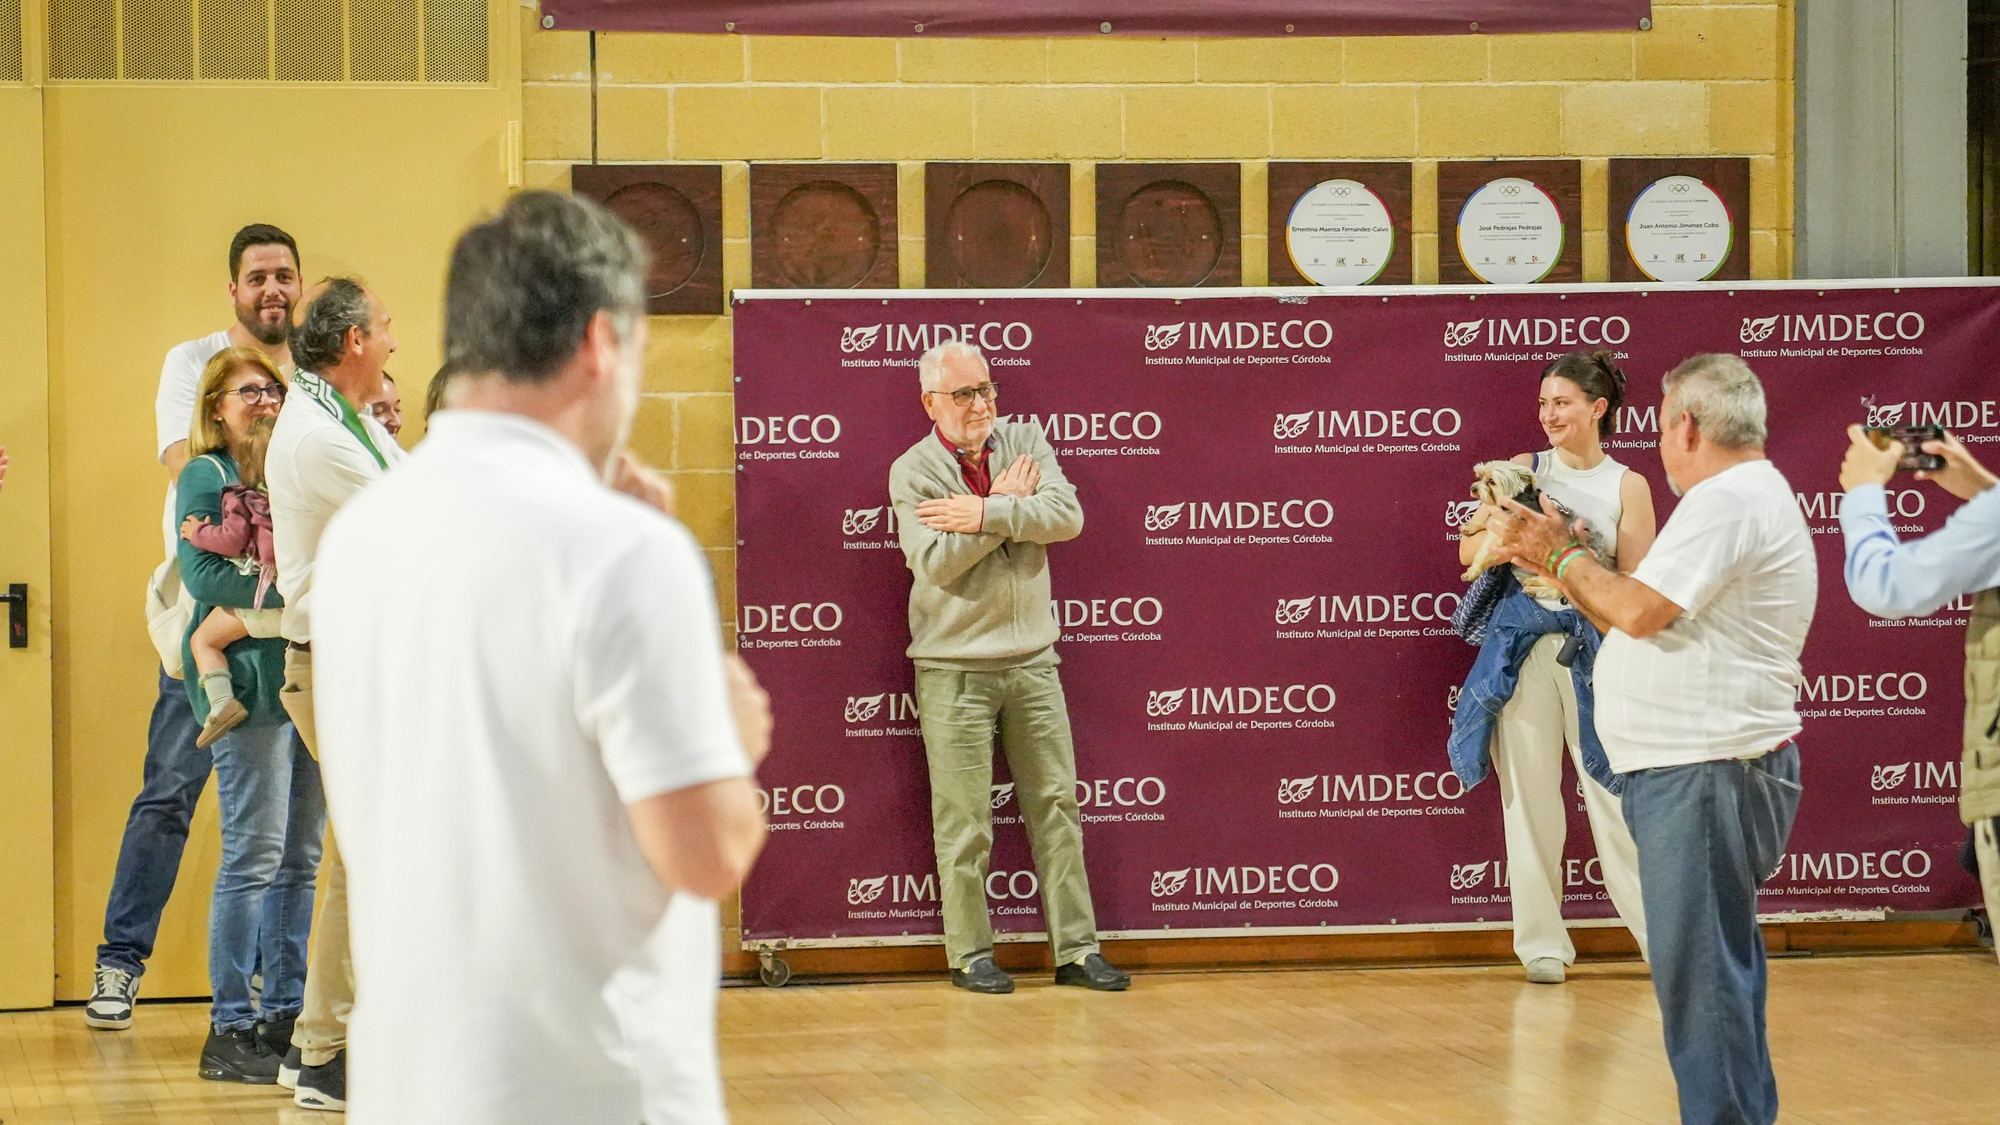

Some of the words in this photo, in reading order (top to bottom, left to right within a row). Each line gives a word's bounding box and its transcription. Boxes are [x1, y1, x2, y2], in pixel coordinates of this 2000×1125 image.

[1488, 316, 1630, 346] IMDECO
[1783, 312, 1925, 342] IMDECO
[886, 322, 1032, 351] IMDECO
[1189, 320, 1333, 349] IMDECO
[1445, 353, 1482, 362] Instituto
[1484, 352, 1529, 363] Municipal
[1531, 352, 1543, 361] de
[1741, 349, 1778, 358] Instituto
[1780, 348, 1824, 358] Municipal
[1827, 348, 1839, 356] de
[1841, 348, 1882, 358] Deportes
[1884, 347, 1923, 355] Córdoba
[842, 358, 880, 367] Instituto
[883, 358, 920, 369] Municip
[991, 357, 1031, 366] Córdoba
[1146, 356, 1183, 365] Instituto
[1185, 356, 1230, 366] Municipal
[1233, 356, 1245, 364] de
[1248, 355, 1289, 365] Deportes
[1292, 354, 1331, 363] Córdoba
[1910, 401, 2000, 428] IMDE
[1318, 408, 1461, 438] IMDECO
[734, 414, 841, 445] DECO
[1274, 445, 1312, 453] Instituto
[1315, 444, 1359, 455] Municipal
[1362, 444, 1374, 452] de
[1377, 444, 1418, 454] Deportes
[1421, 443, 1460, 452] Córdoba
[1612, 440, 1656, 450] Municipal
[740, 451, 752, 460] de
[754, 451, 796, 461] Deportes
[799, 450, 840, 459] Córdoba
[1061, 448, 1074, 456] de
[1076, 448, 1118, 457] Deportes
[1121, 447, 1160, 456] Córdoba
[1189, 500, 1334, 530] IMDECO
[1828, 526, 1839, 534] de
[1893, 525, 1924, 533] órdoba
[843, 541, 881, 549] Instituto
[1146, 537, 1183, 545] Instituto
[1186, 536, 1231, 546] Municipal
[1234, 536, 1246, 544] de
[1249, 536, 1290, 545] Deportes
[1293, 534, 1332, 543] Córdoba
[1320, 593, 1462, 623] IMDECO
[737, 602, 843, 633] DECO
[1869, 619, 1906, 627] Instituto
[1909, 618, 1952, 628] Municipal
[1955, 618, 1967, 626] de
[1062, 633, 1074, 642] de
[1077, 633, 1118, 643] Deportes
[1122, 632, 1161, 641] Córdoba
[1276, 630, 1314, 639] Instituto
[1316, 629, 1361, 640] Municipal
[1364, 629, 1376, 637] de
[1379, 629, 1420, 639] Deportes
[741, 640, 754, 649] de
[757, 640, 798, 650] Deportes
[802, 638, 841, 647] Córdoba
[1796, 672, 1927, 702] MDECO
[1191, 684, 1336, 715] IMDECO
[1795, 709, 1827, 718] nicipal
[1829, 709, 1841, 717] de
[1844, 708, 1884, 718] Deportes
[1887, 707, 1926, 716] Córdoba
[1148, 722, 1186, 731] Instituto
[1188, 721, 1233, 732] Municipal
[1236, 721, 1248, 729] de
[1251, 720, 1292, 730] Deportes
[1295, 719, 1335, 728] Córdoba
[846, 728, 883, 737] Instituto
[886, 727, 922, 738] Municip
[1076, 777, 1166, 807] DECO
[1322, 771, 1464, 803] IMDECO
[754, 784, 845, 815] DECO
[1872, 796, 1909, 805] Instituto
[1911, 795, 1955, 806] Municipal
[992, 815, 1015, 824] ituto
[1081, 814, 1122, 824] Deportes
[1125, 813, 1165, 822] Córdoba
[1279, 809, 1316, 818] Instituto
[1319, 808, 1364, 819] Municipal
[1367, 808, 1379, 817] de
[1382, 808, 1422, 818] Deportes
[1426, 807, 1465, 816] Córdoba
[766, 822, 801, 832] eportes
[804, 821, 844, 830] Córdoba
[1790, 850, 1931, 881] IMDECO
[1494, 857, 1606, 888] IEC
[1195, 864, 1339, 895] IMDECO
[892, 871, 1038, 903] IMCO
[1756, 887, 1784, 896] stituto
[1787, 886, 1831, 896] Municipal
[1834, 886, 1846, 894] de
[1849, 885, 1890, 896] Deportes
[1892, 885, 1930, 893] Córdoba
[1152, 903, 1190, 912] Instituto
[1192, 901, 1237, 912] Municipal
[1240, 901, 1252, 910] de
[1255, 901, 1296, 911] Deportes
[1299, 899, 1338, 908] Córdoba
[1451, 895, 1488, 904] Instituto
[848, 910, 886, 919] Instituto
[889, 909, 934, 920] Municipal
[997, 906, 1037, 916] Córdoba
